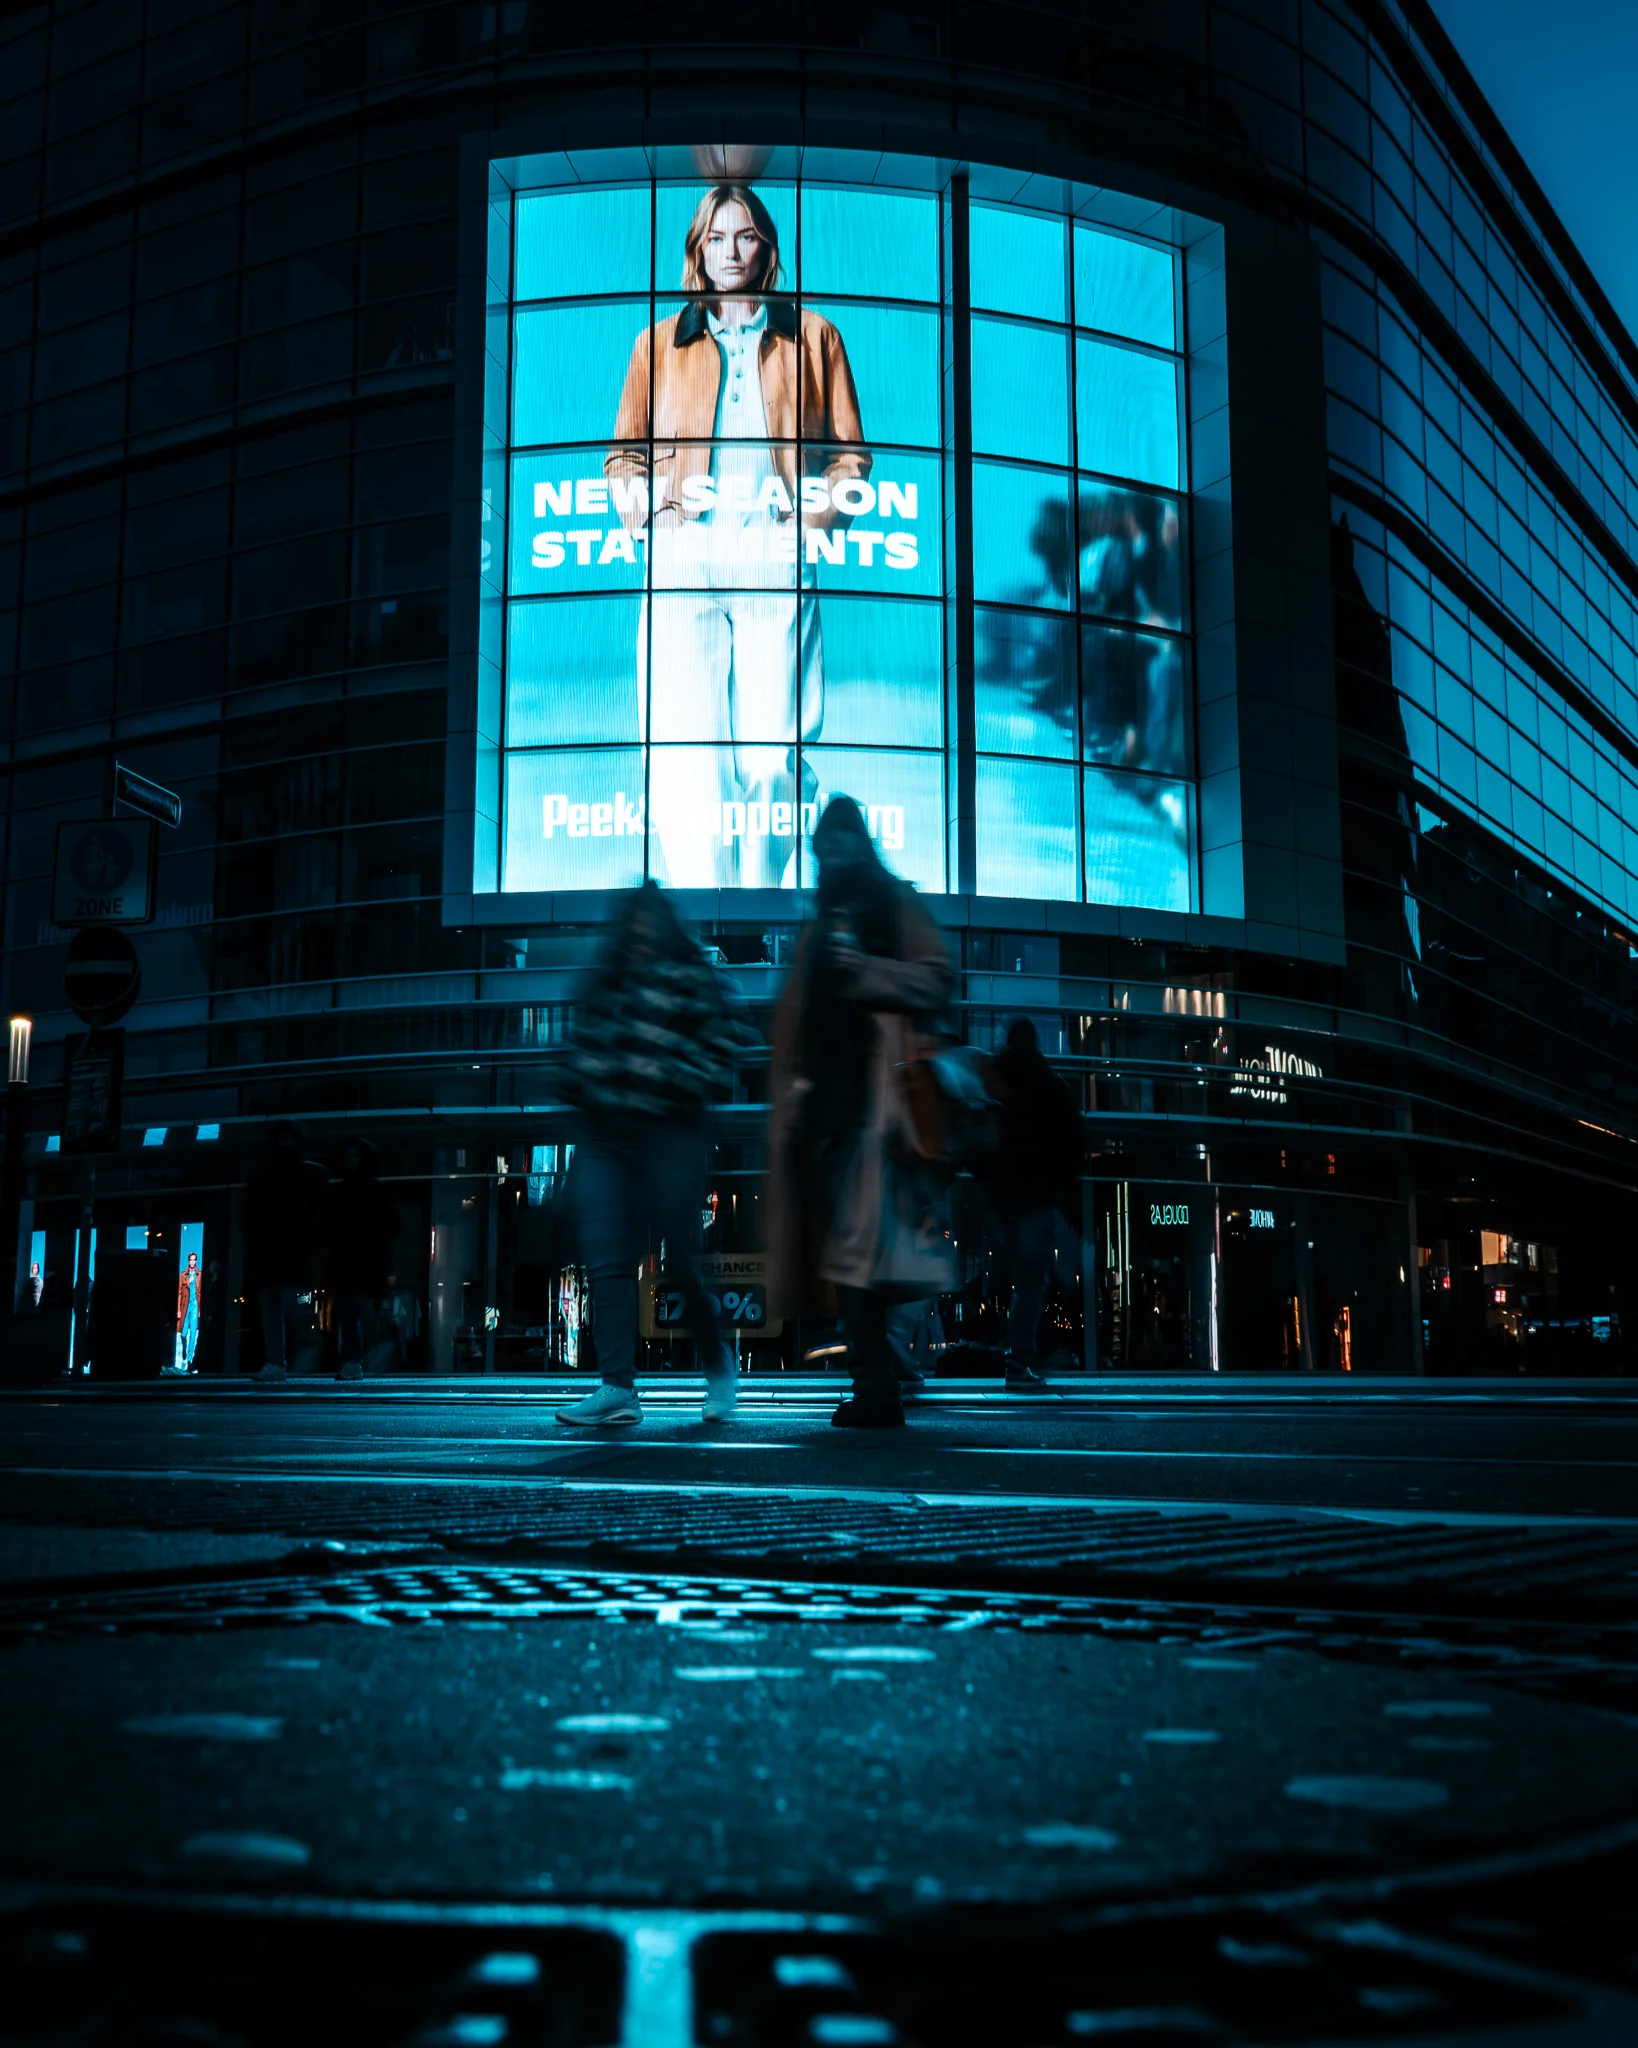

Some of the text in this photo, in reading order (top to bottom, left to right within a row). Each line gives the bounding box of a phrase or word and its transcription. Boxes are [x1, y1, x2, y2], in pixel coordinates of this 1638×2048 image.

[533, 474, 919, 519] NEW SEASON
[531, 527, 919, 570] STATENTS
[74, 896, 125, 916] ZONE
[701, 1261, 766, 1274] CHANCE
